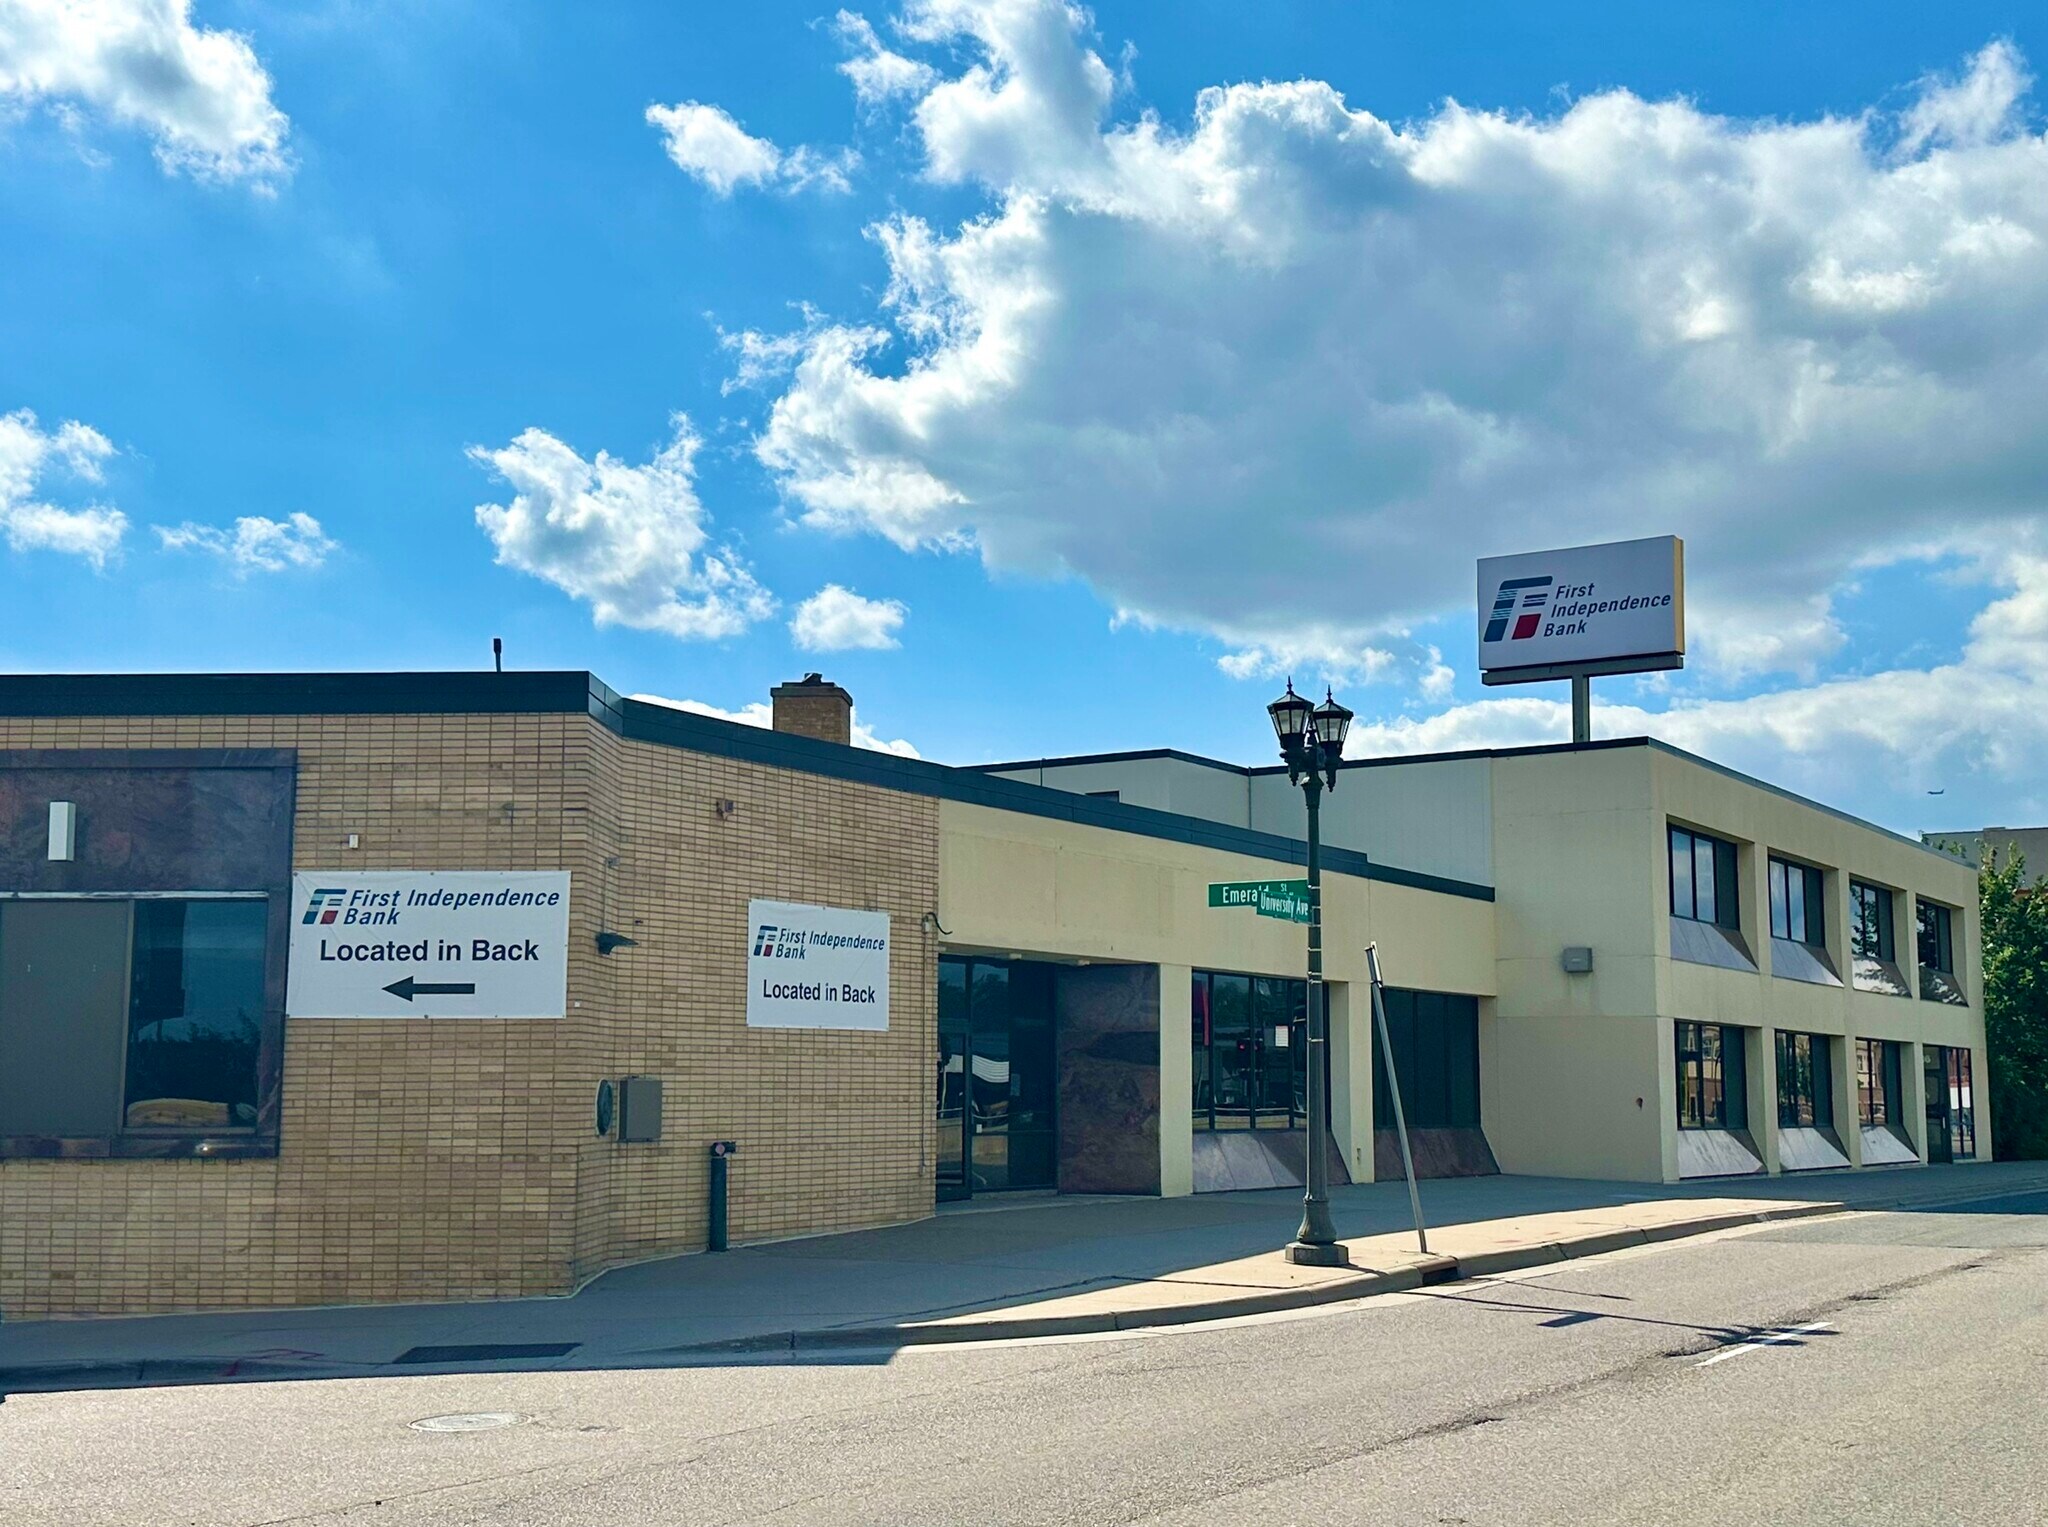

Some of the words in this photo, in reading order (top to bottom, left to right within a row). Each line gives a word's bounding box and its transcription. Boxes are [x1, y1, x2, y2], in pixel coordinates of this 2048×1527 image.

[1555, 582, 1595, 600] First
[1551, 594, 1671, 618] Independence
[1543, 619, 1588, 637] Bank
[350, 889, 401, 906] First
[407, 888, 560, 910] Independence
[1260, 892, 1295, 918] University
[1295, 897, 1309, 916] Ave
[343, 908, 401, 925] Bank
[320, 939, 428, 961] Located
[437, 939, 461, 961] in
[471, 939, 540, 961] Back
[779, 928, 807, 945] First
[809, 930, 885, 951] Independence
[776, 943, 807, 960] Bank
[763, 979, 821, 1001] Located
[825, 983, 838, 1002] in
[842, 984, 876, 1004] Back
